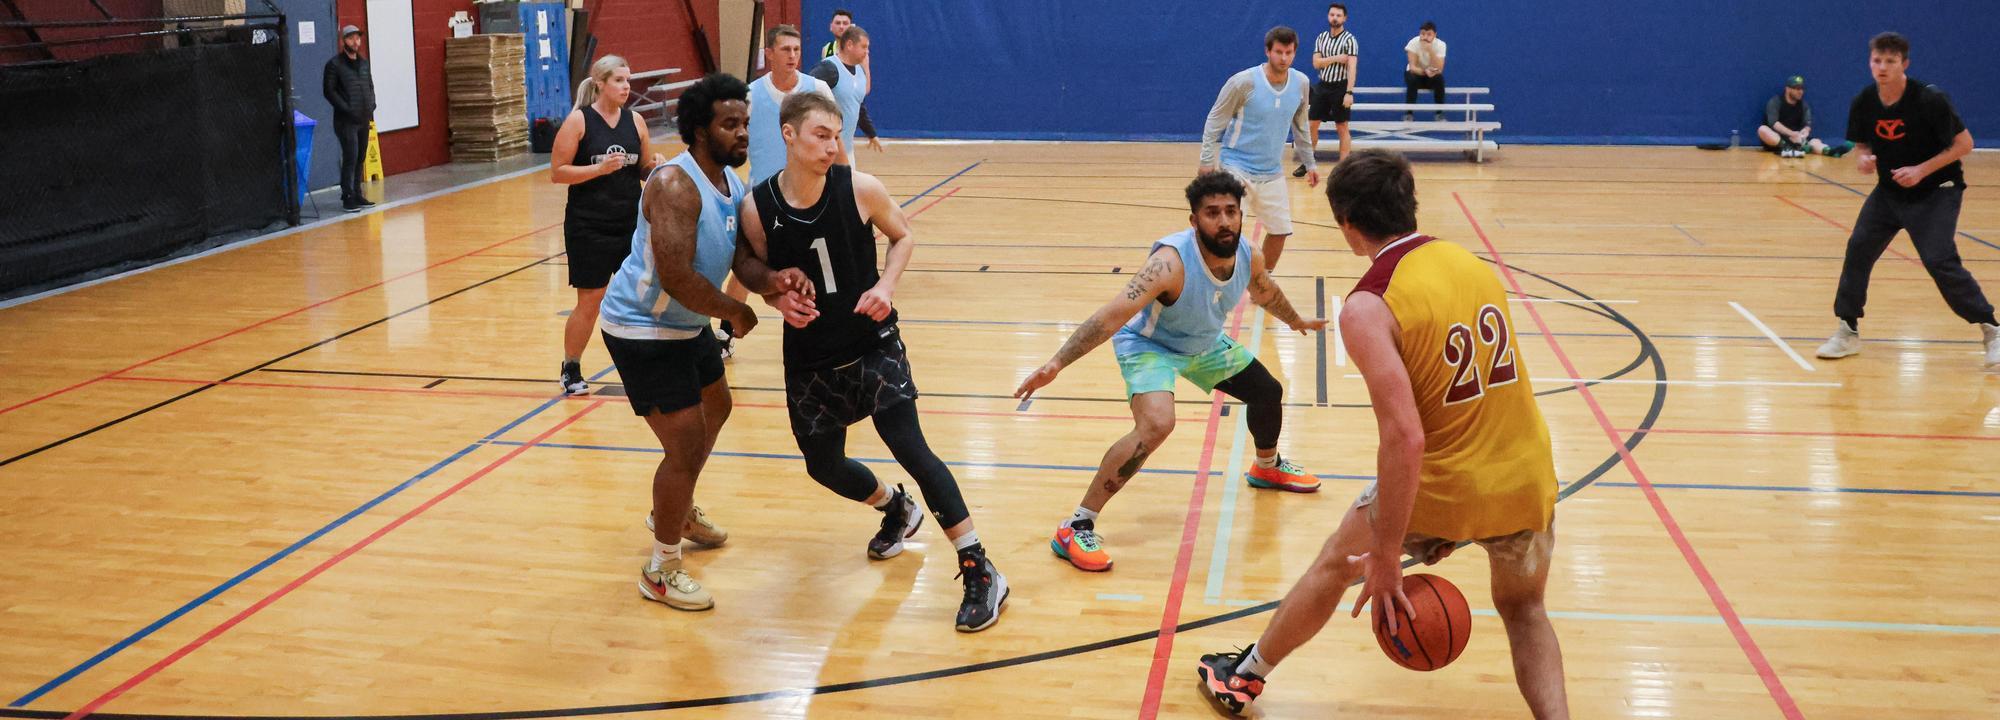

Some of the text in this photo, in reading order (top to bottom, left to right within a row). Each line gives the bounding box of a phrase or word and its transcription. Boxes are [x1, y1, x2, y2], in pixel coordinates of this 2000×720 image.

[726, 215, 736, 231] R
[809, 237, 837, 294] 1
[1443, 304, 1518, 406] 22
